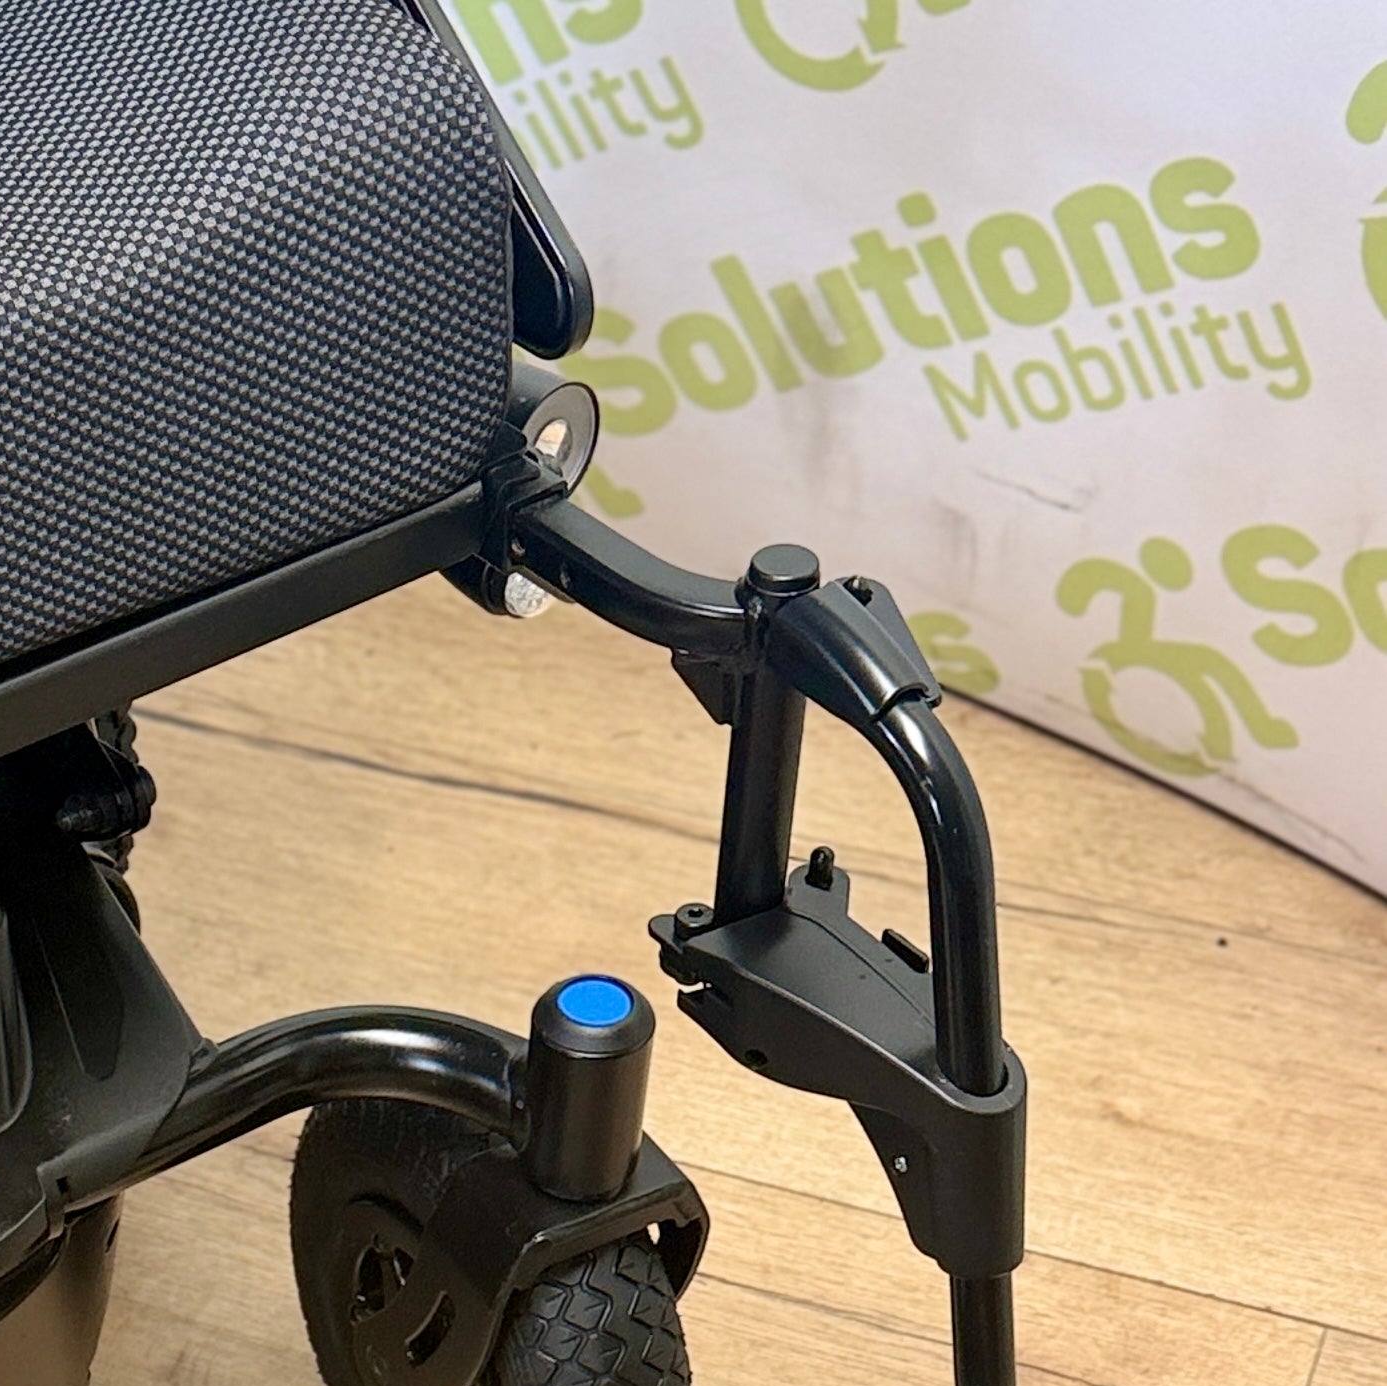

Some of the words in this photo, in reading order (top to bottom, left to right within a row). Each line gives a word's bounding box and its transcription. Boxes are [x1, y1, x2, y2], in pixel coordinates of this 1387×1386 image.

[512, 54, 704, 170] ility
[557, 157, 1260, 438] Solutions
[921, 302, 1313, 442] Mobility
